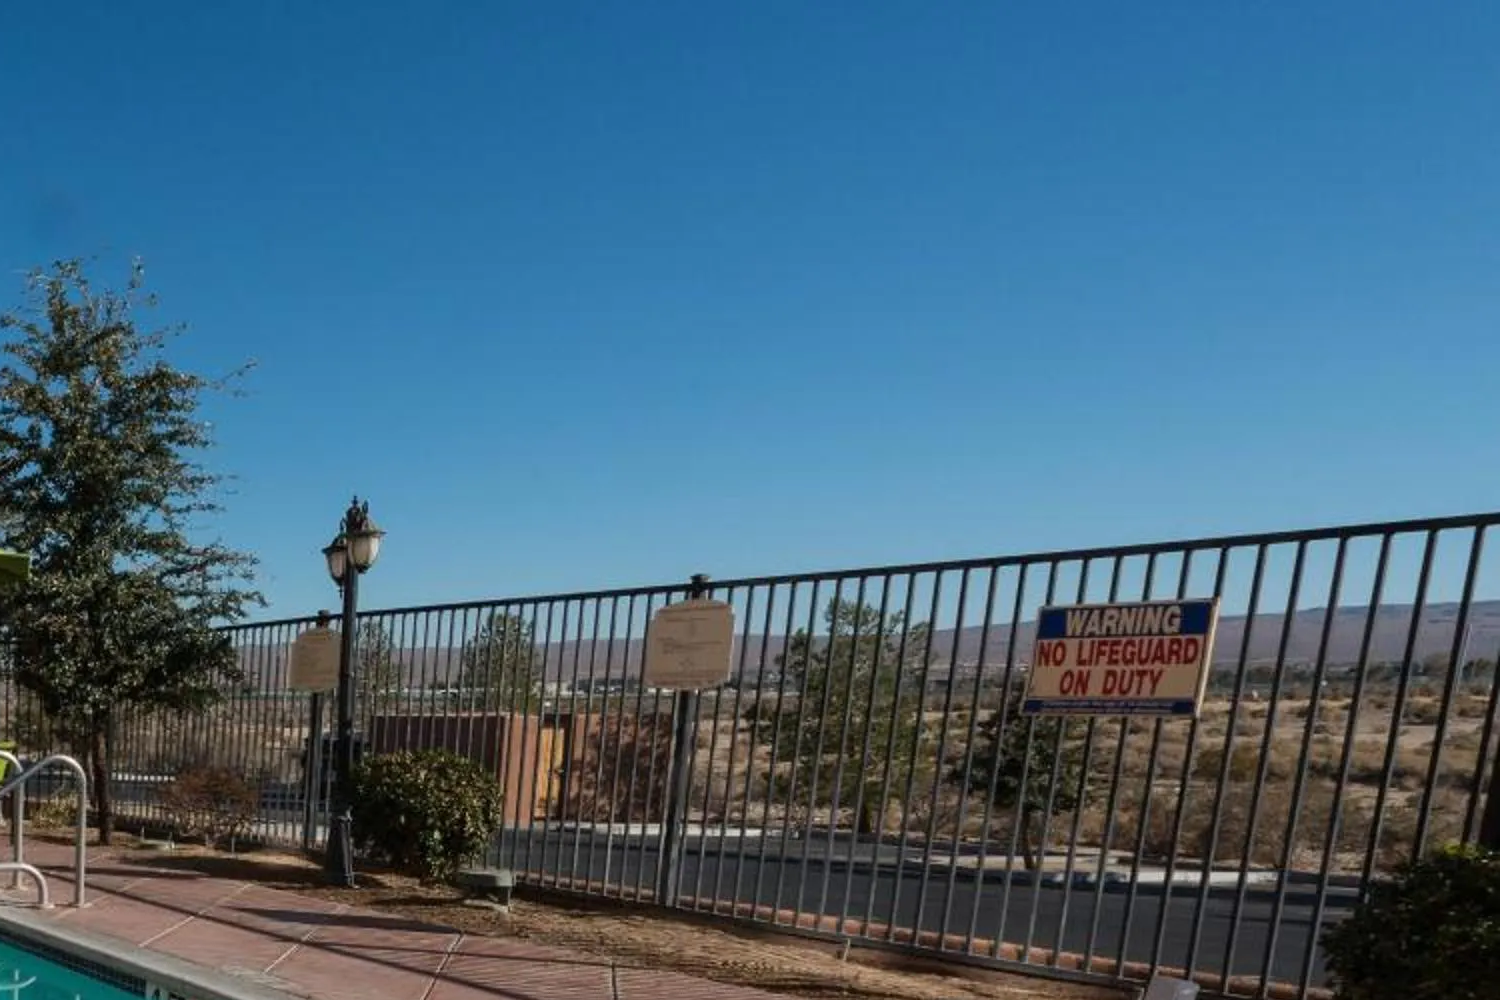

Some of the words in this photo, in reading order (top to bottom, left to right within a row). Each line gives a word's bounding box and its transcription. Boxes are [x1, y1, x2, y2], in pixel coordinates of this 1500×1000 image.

[1065, 604, 1182, 636] WARNING
[1037, 640, 1067, 667] NO
[1075, 637, 1199, 667] LIFEGUARD
[1059, 669, 1091, 696] ON
[1102, 668, 1164, 696] DUTY
